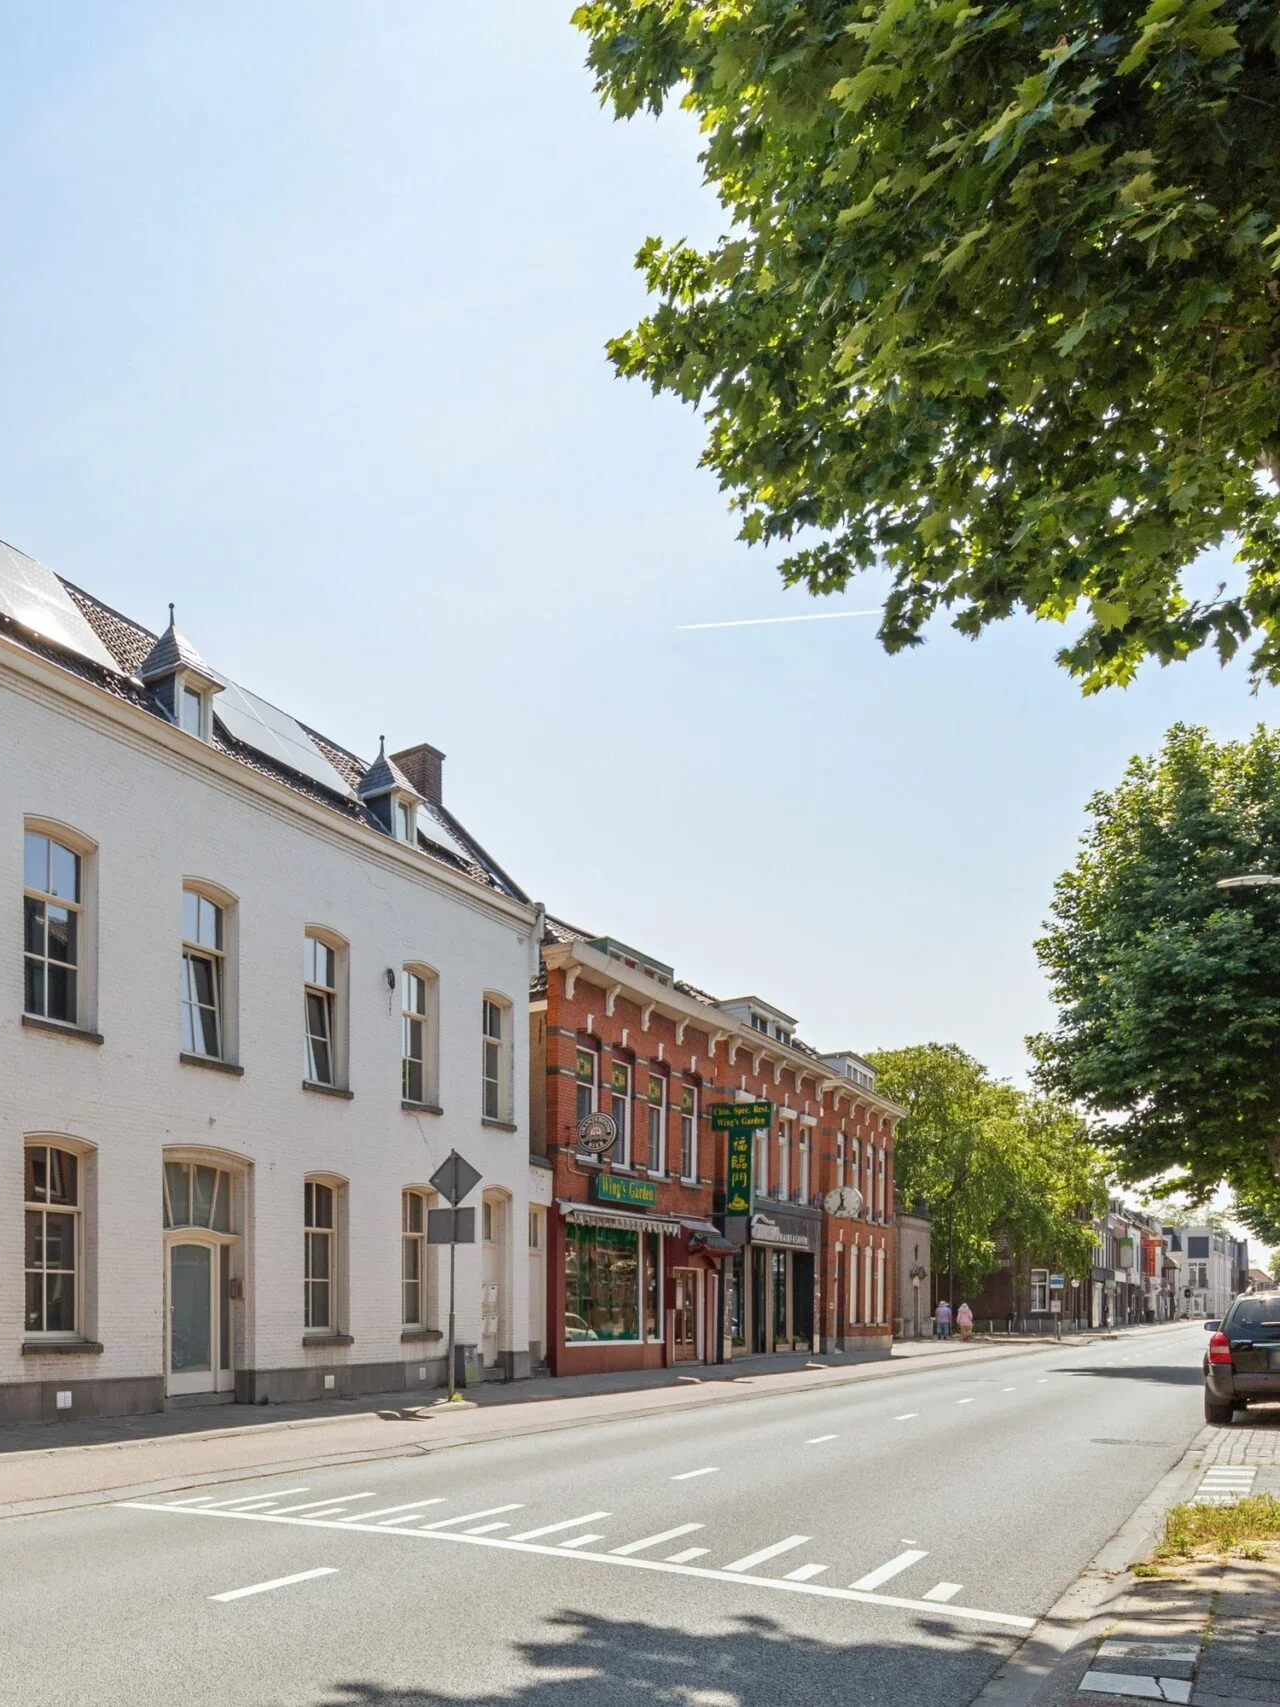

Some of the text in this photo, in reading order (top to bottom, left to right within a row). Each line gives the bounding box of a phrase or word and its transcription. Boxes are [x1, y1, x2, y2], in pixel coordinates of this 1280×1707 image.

[741, 1116, 766, 1125] Garden
[602, 1175, 654, 1201] Wing's Garden
